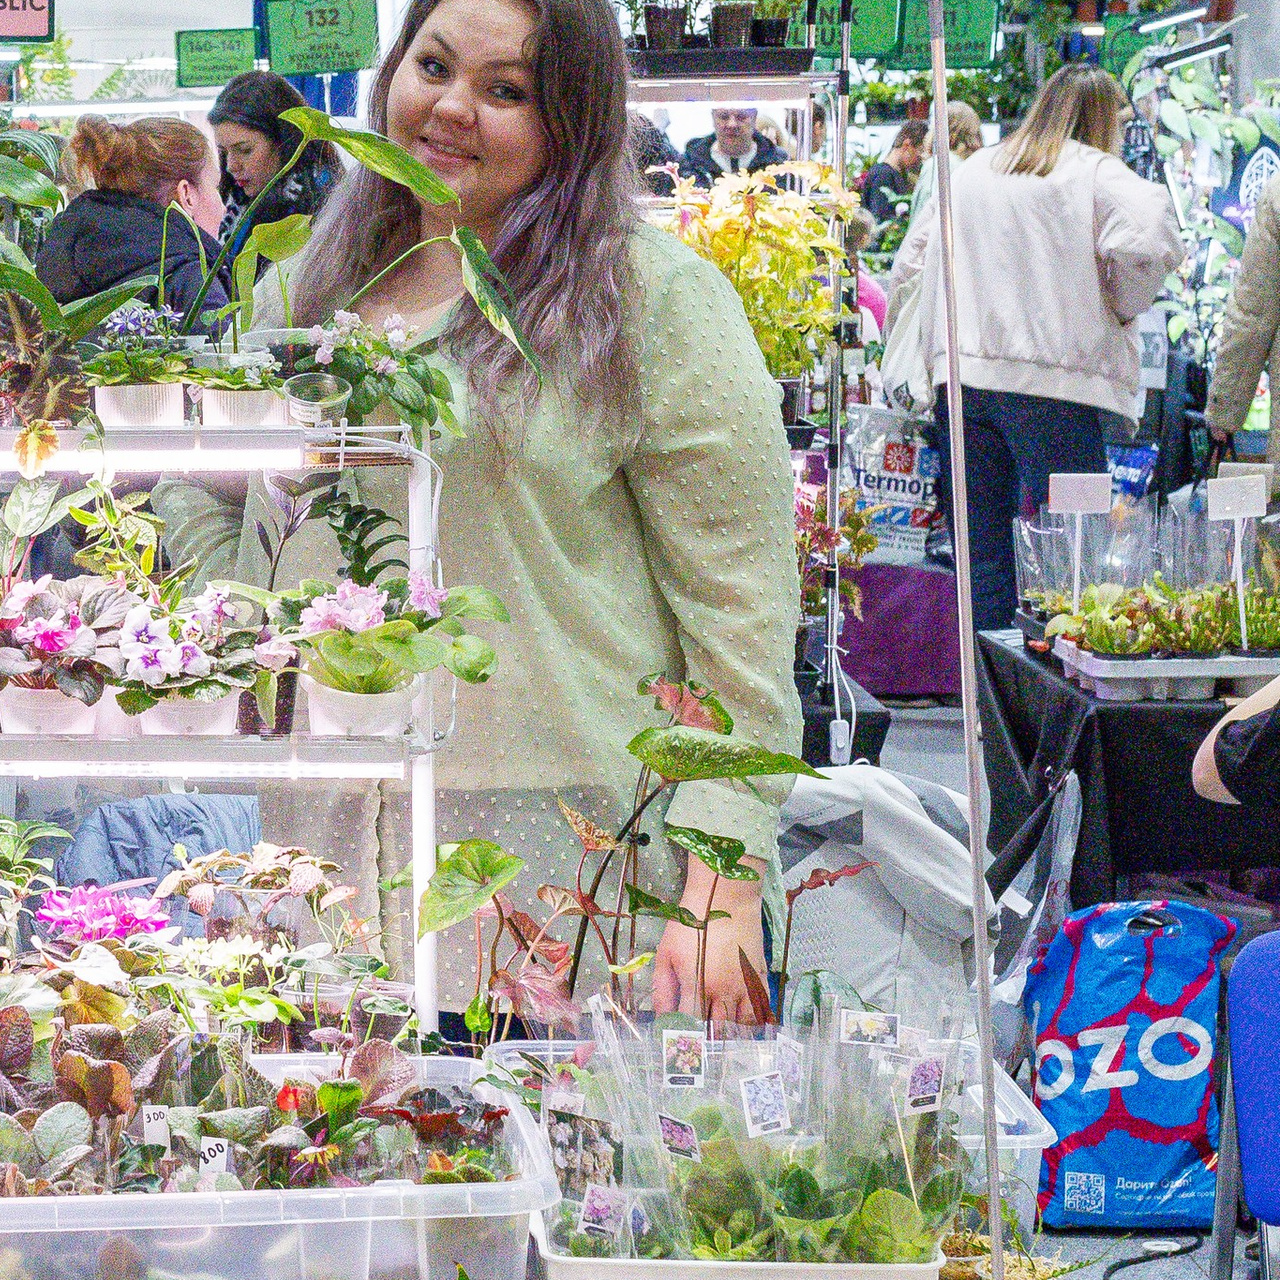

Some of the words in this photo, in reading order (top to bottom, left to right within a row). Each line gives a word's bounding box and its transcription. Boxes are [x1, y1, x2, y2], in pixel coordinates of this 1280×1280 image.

[305, 8, 340, 27] 132
[145, 1110, 166, 1124] 300
[199, 1142, 225, 1165] 800
